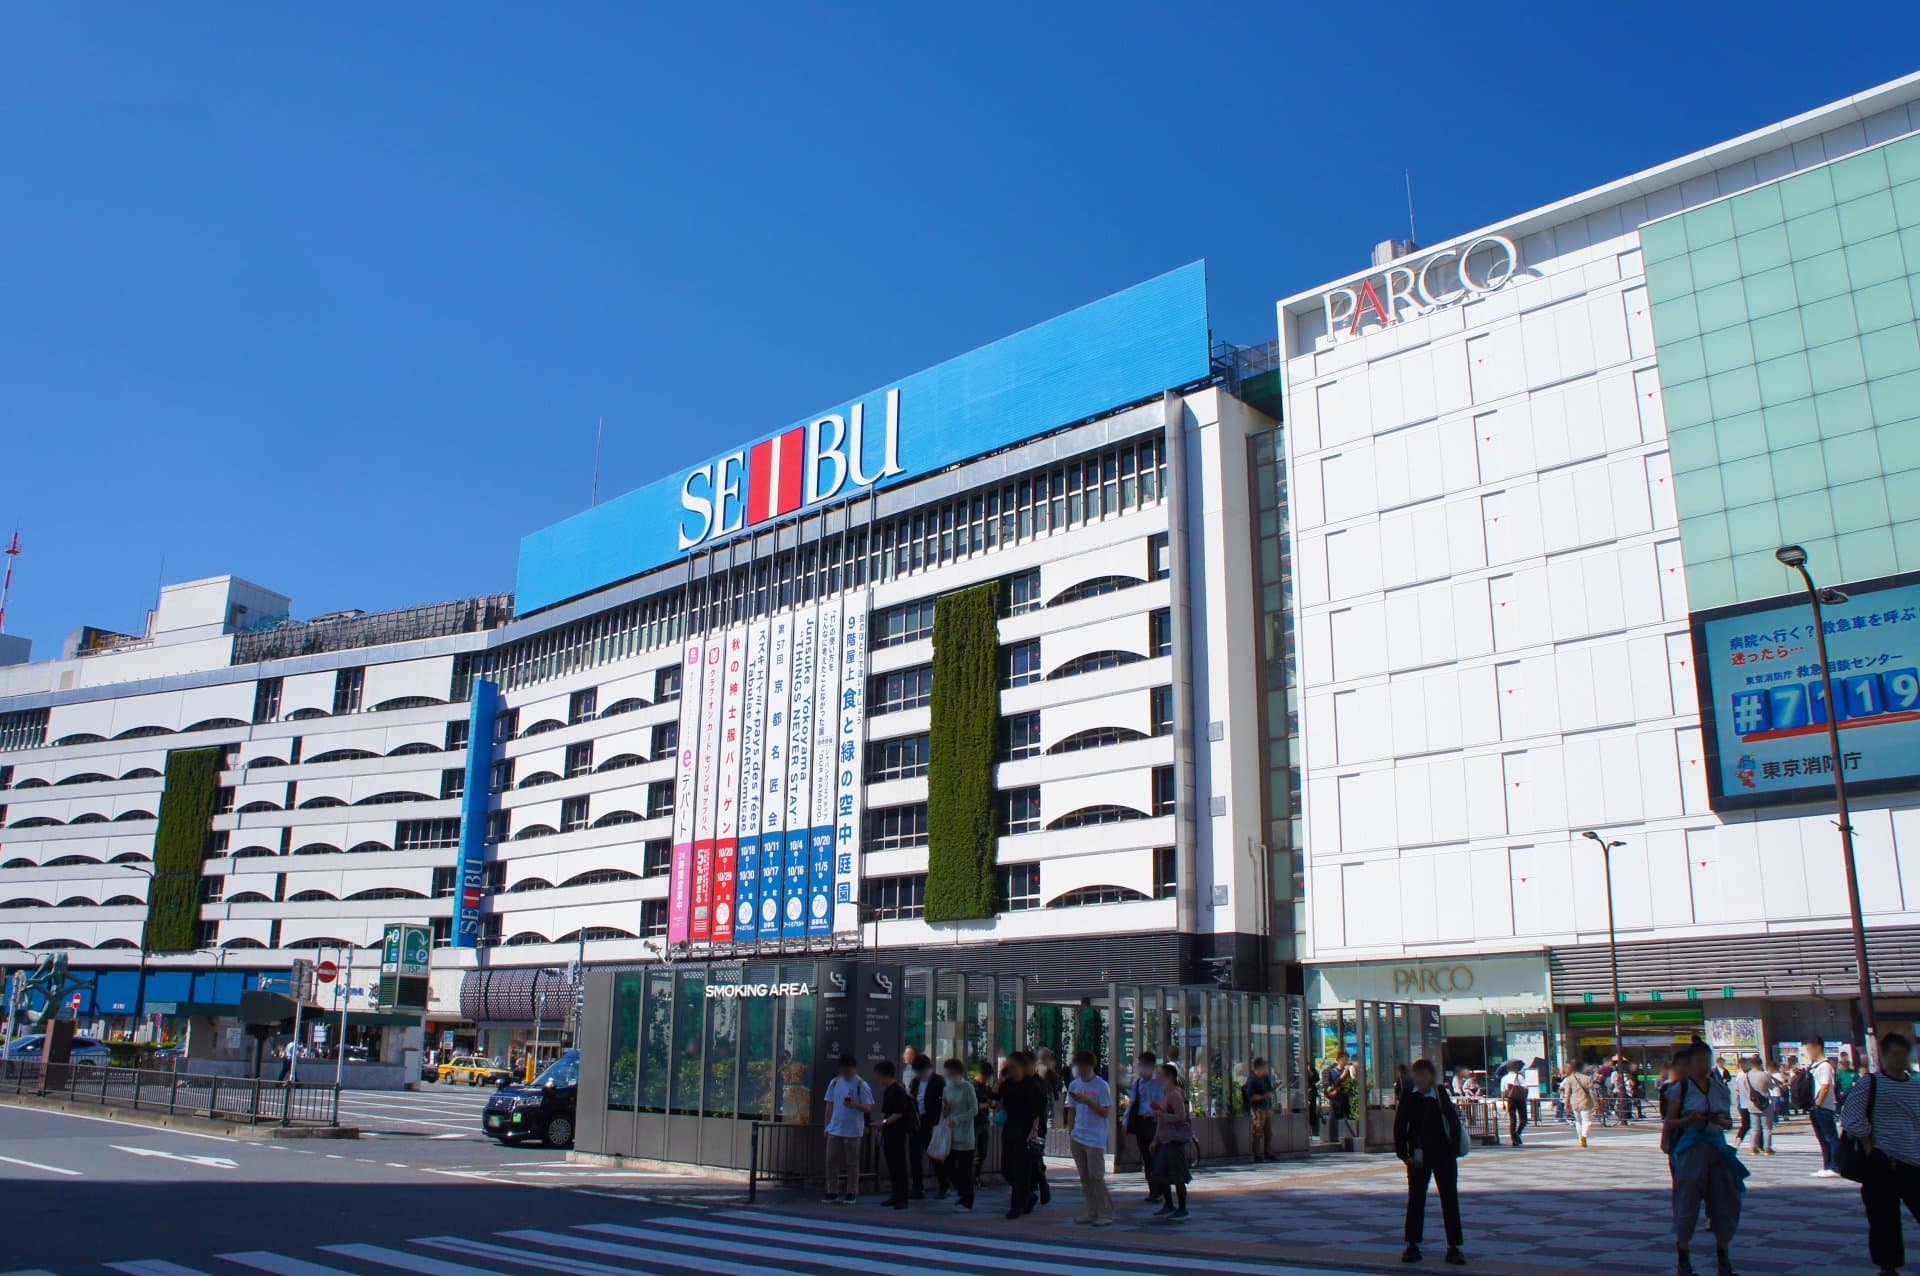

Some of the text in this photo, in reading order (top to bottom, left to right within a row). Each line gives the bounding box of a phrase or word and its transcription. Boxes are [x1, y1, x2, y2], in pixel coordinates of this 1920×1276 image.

[1322, 235, 1517, 343] PARCO
[679, 387, 906, 550] SEIBU
[1823, 607, 1920, 635] 救急車を呼ぶ
[758, 630, 766, 665] スズキ
[747, 659, 756, 719] Tabulae
[800, 618, 814, 780] Junsuke Yokoyama
[1734, 674, 1918, 732] #719
[722, 638, 740, 833] 秋の紳士服バーゲン
[792, 709, 801, 766] NEVER
[768, 680, 783, 827] 京都名匠会
[752, 762, 760, 789] des
[750, 795, 759, 830] fées
[764, 842, 779, 852] 10/11
[790, 840, 803, 850] 10/4
[813, 836, 830, 846] 10/20
[740, 870, 754, 880] 10/30
[763, 867, 779, 877] 10/17
[788, 866, 804, 876] 10/16
[815, 862, 828, 872] 11/5
[460, 859, 483, 934] SEIBU
[705, 982, 810, 998] SMOKING AREA
[1392, 965, 1474, 994] PARCO
